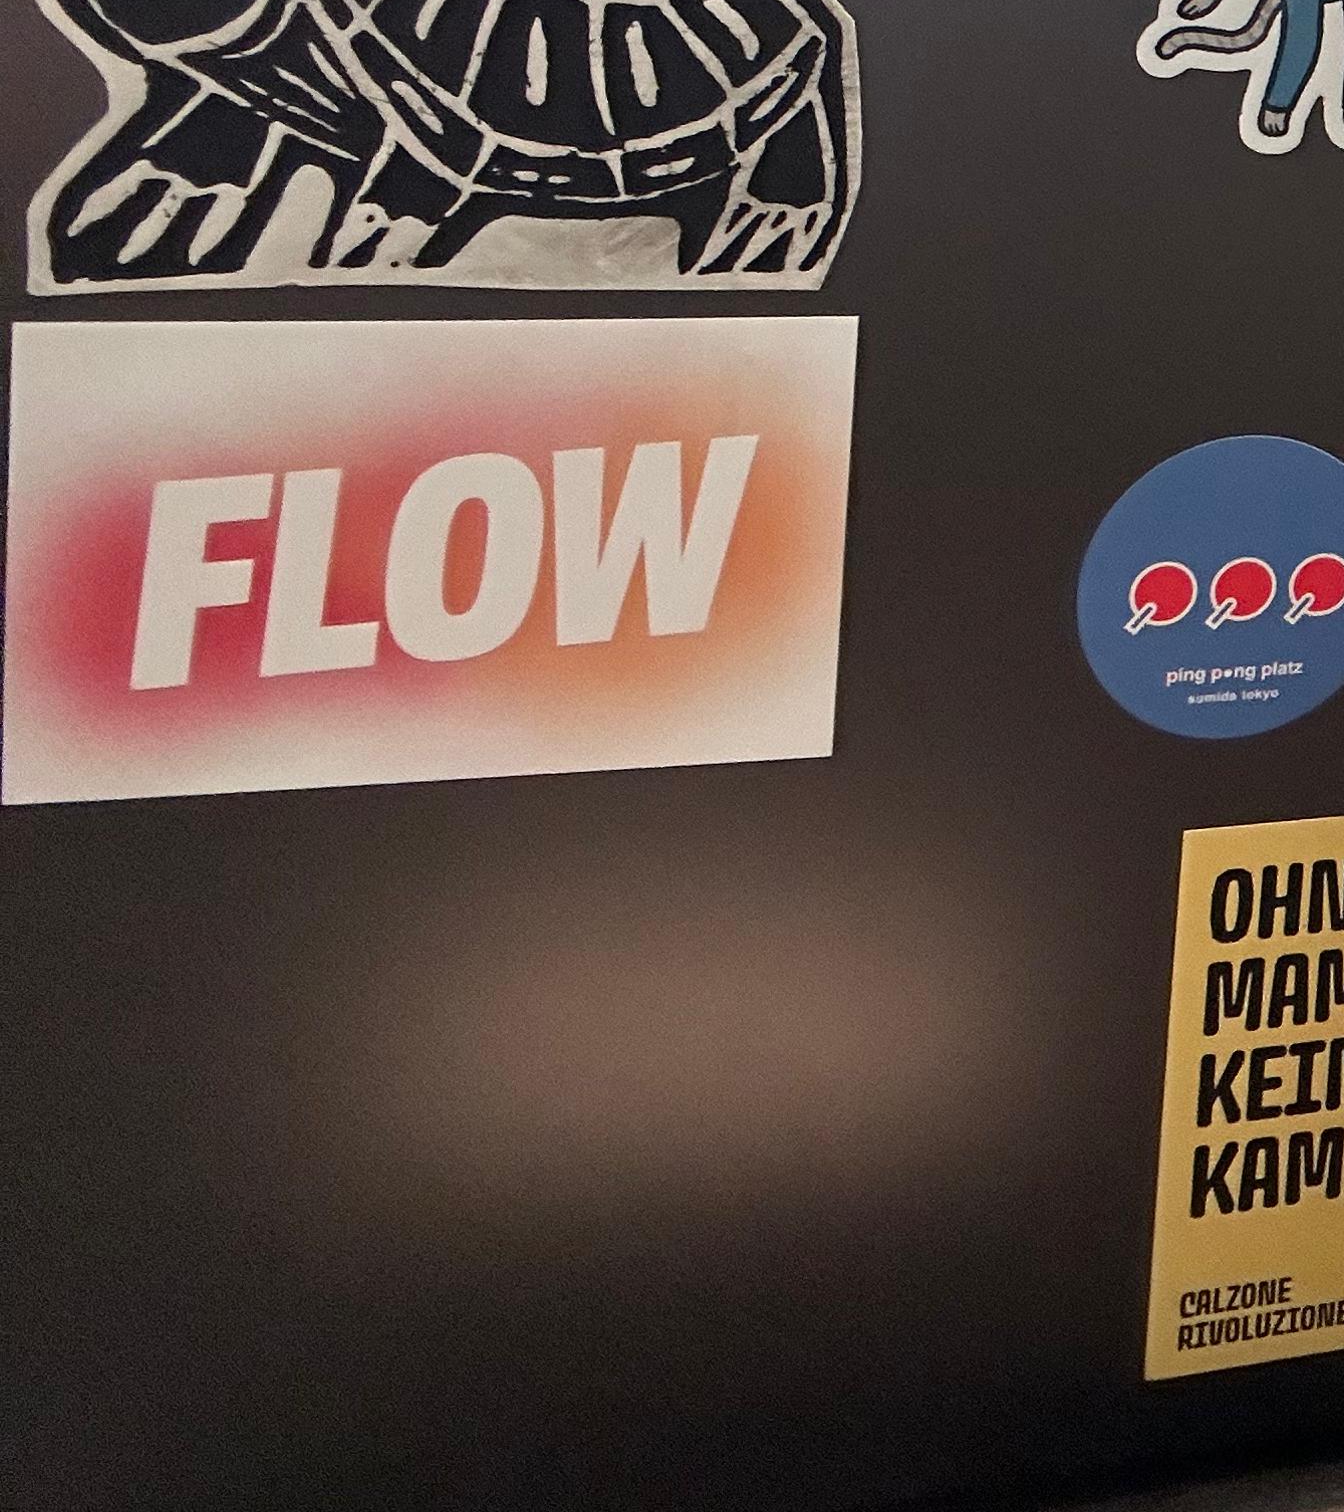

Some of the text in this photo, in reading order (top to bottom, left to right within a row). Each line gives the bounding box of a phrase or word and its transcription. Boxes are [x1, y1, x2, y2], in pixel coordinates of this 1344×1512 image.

[130, 433, 760, 692] FLOW
[1165, 667, 1206, 687] ping
[1260, 661, 1304, 681] platz
[1179, 1276, 1293, 1319] CALZONE
